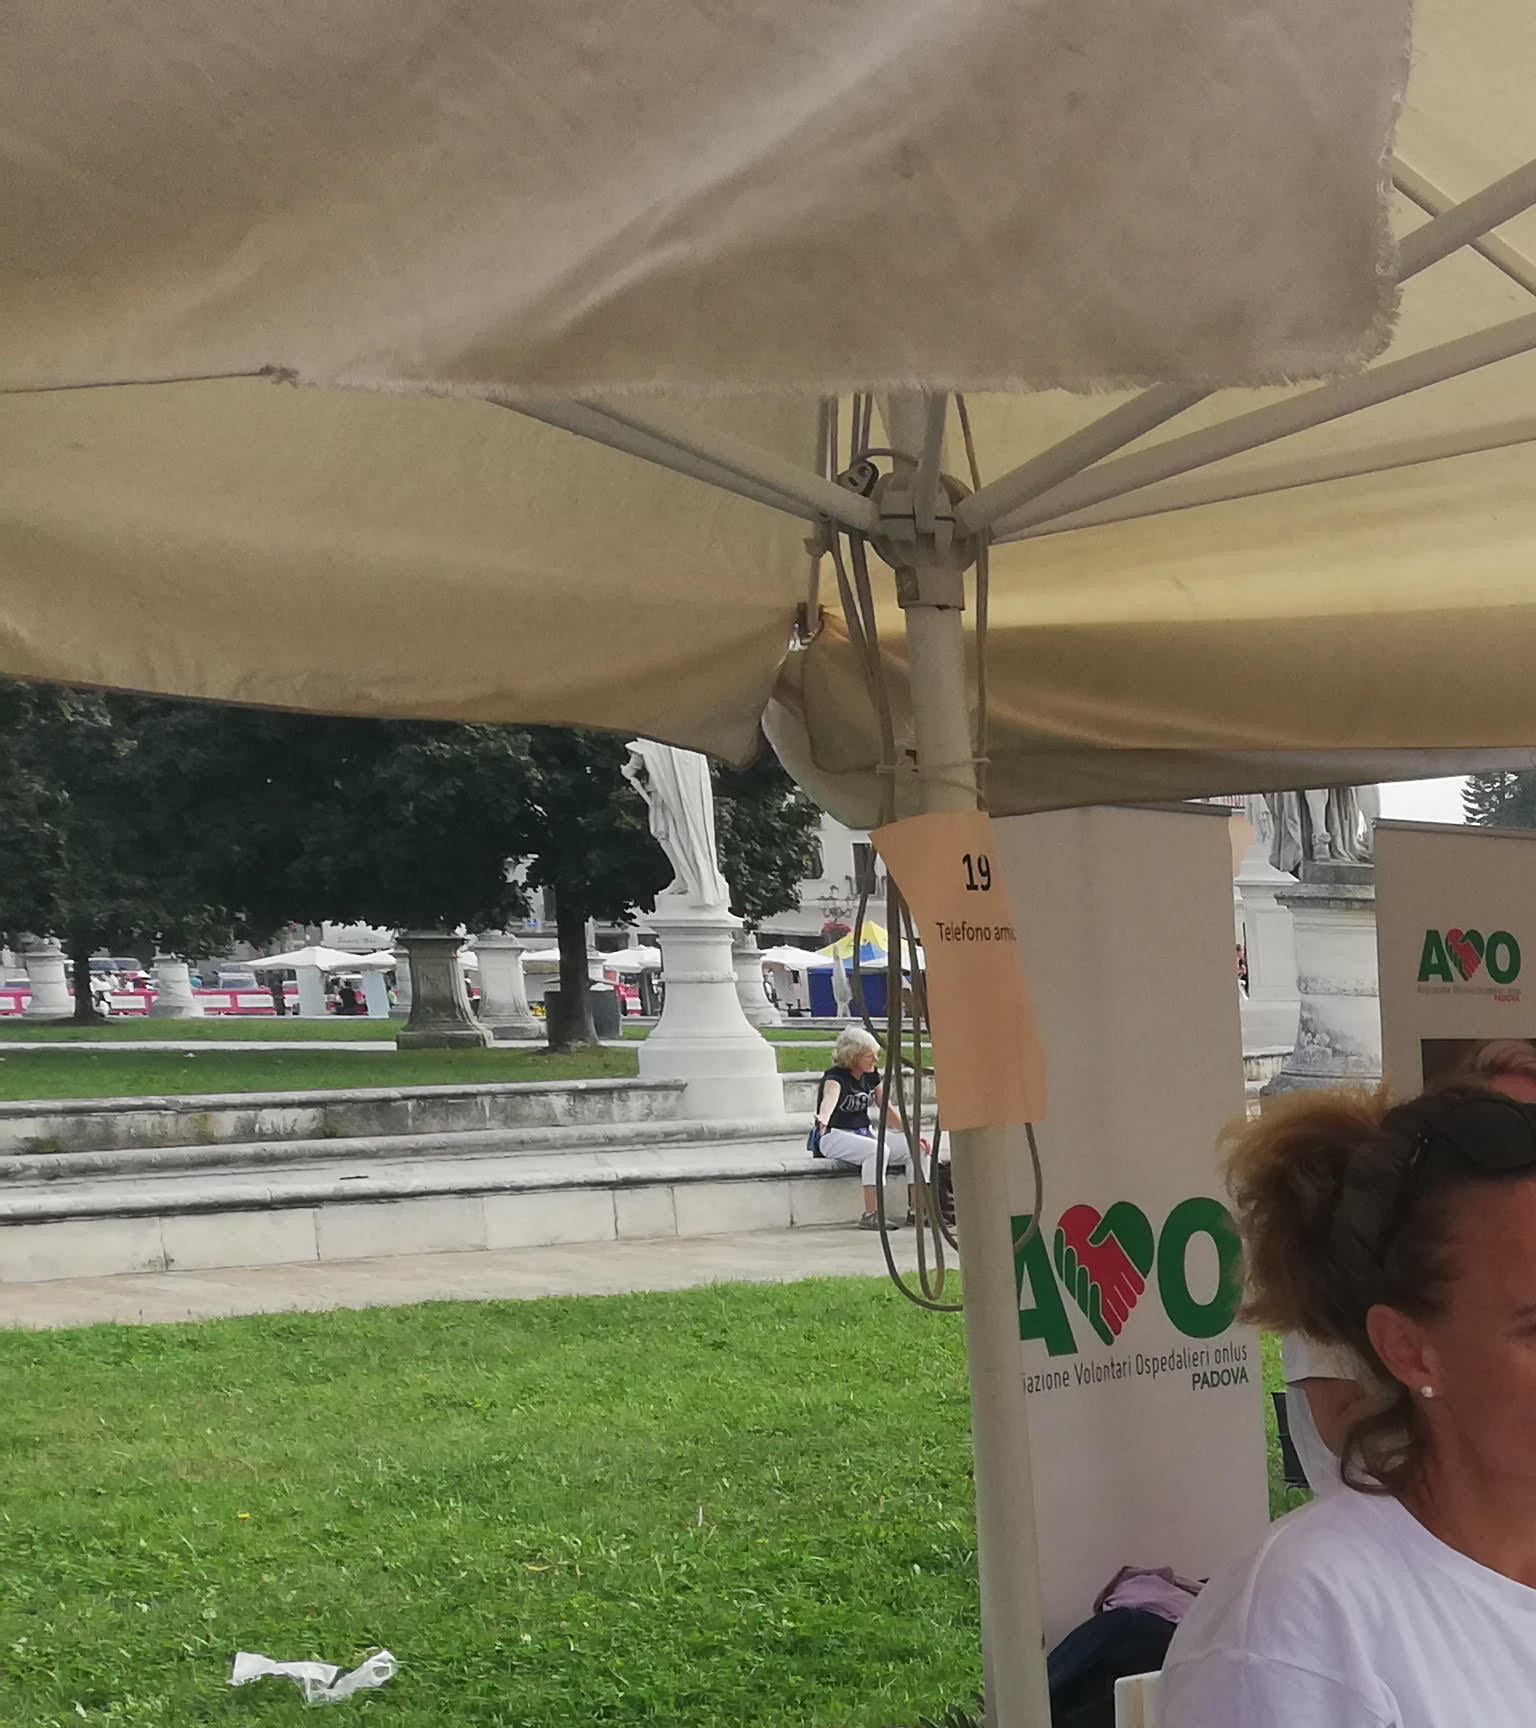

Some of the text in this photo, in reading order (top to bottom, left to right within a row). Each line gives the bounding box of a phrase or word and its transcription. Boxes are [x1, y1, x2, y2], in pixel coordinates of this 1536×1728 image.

[962, 853, 991, 891] 19
[935, 921, 991, 942] Telefono
[1022, 1341, 1248, 1394] iazione Volontari Ospedalieri onlus
[1191, 1366, 1249, 1391] PADOVA
